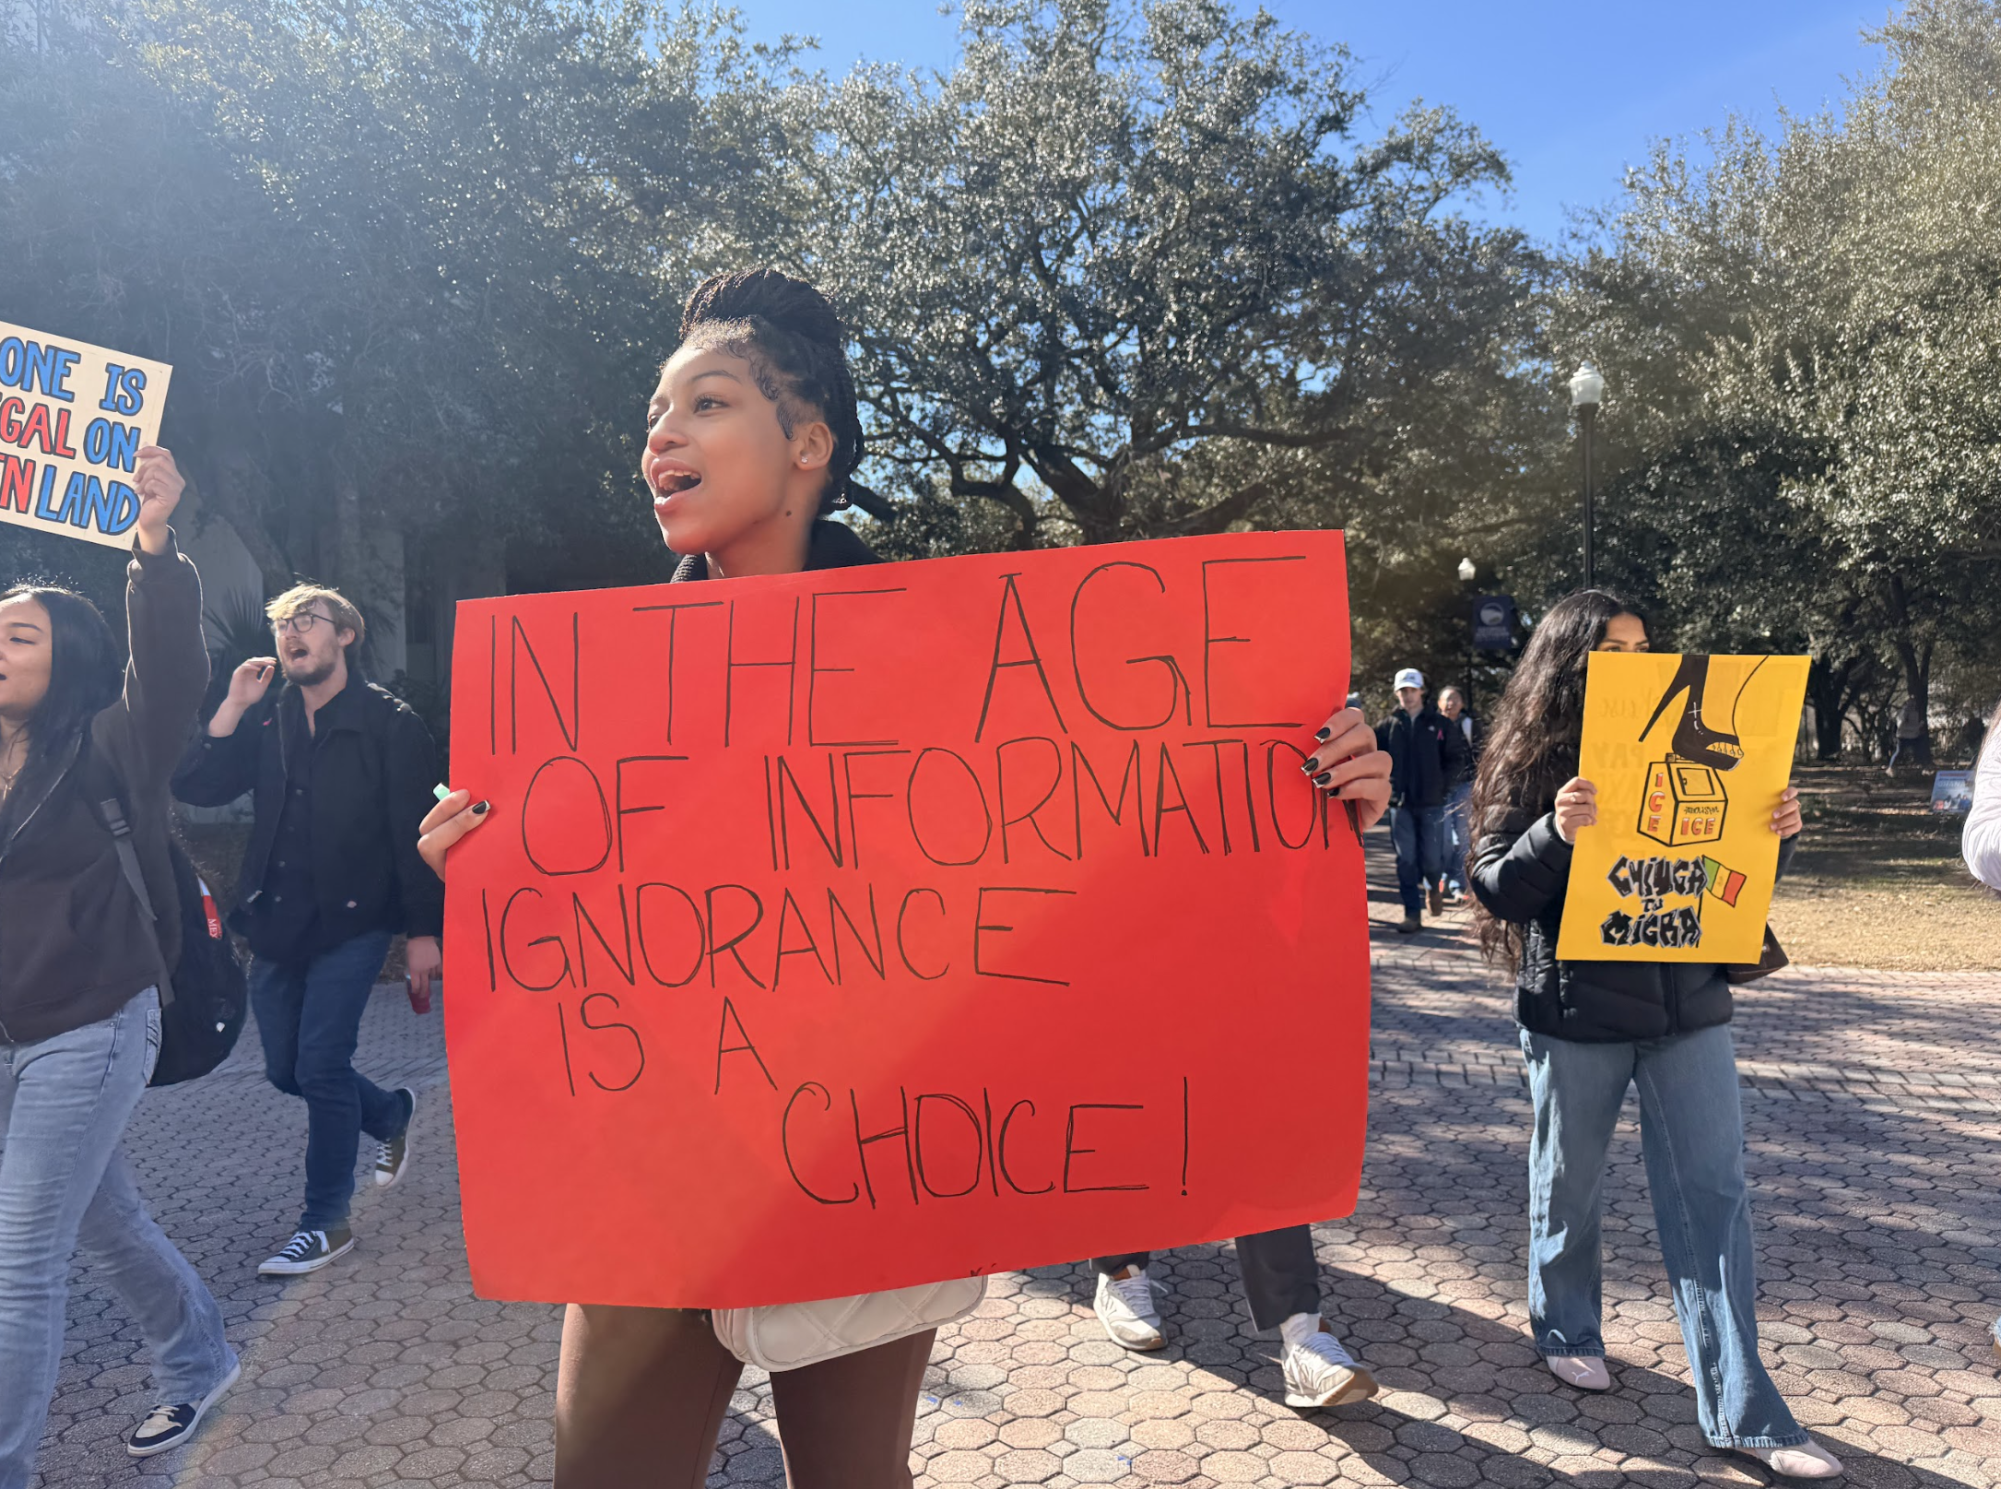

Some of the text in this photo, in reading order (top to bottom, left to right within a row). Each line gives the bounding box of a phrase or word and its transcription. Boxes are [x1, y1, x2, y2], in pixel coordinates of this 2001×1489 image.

[0, 336, 147, 417] ONE IS
[0, 392, 141, 473] GAL ON
[0, 452, 141, 536] N LAND
[491, 555, 1306, 755] IN THE AGE
[522, 755, 690, 877] OF
[1681, 817, 1716, 836] ICE
[481, 882, 1077, 992] IGNORANCE
[558, 992, 778, 1096] IS A
